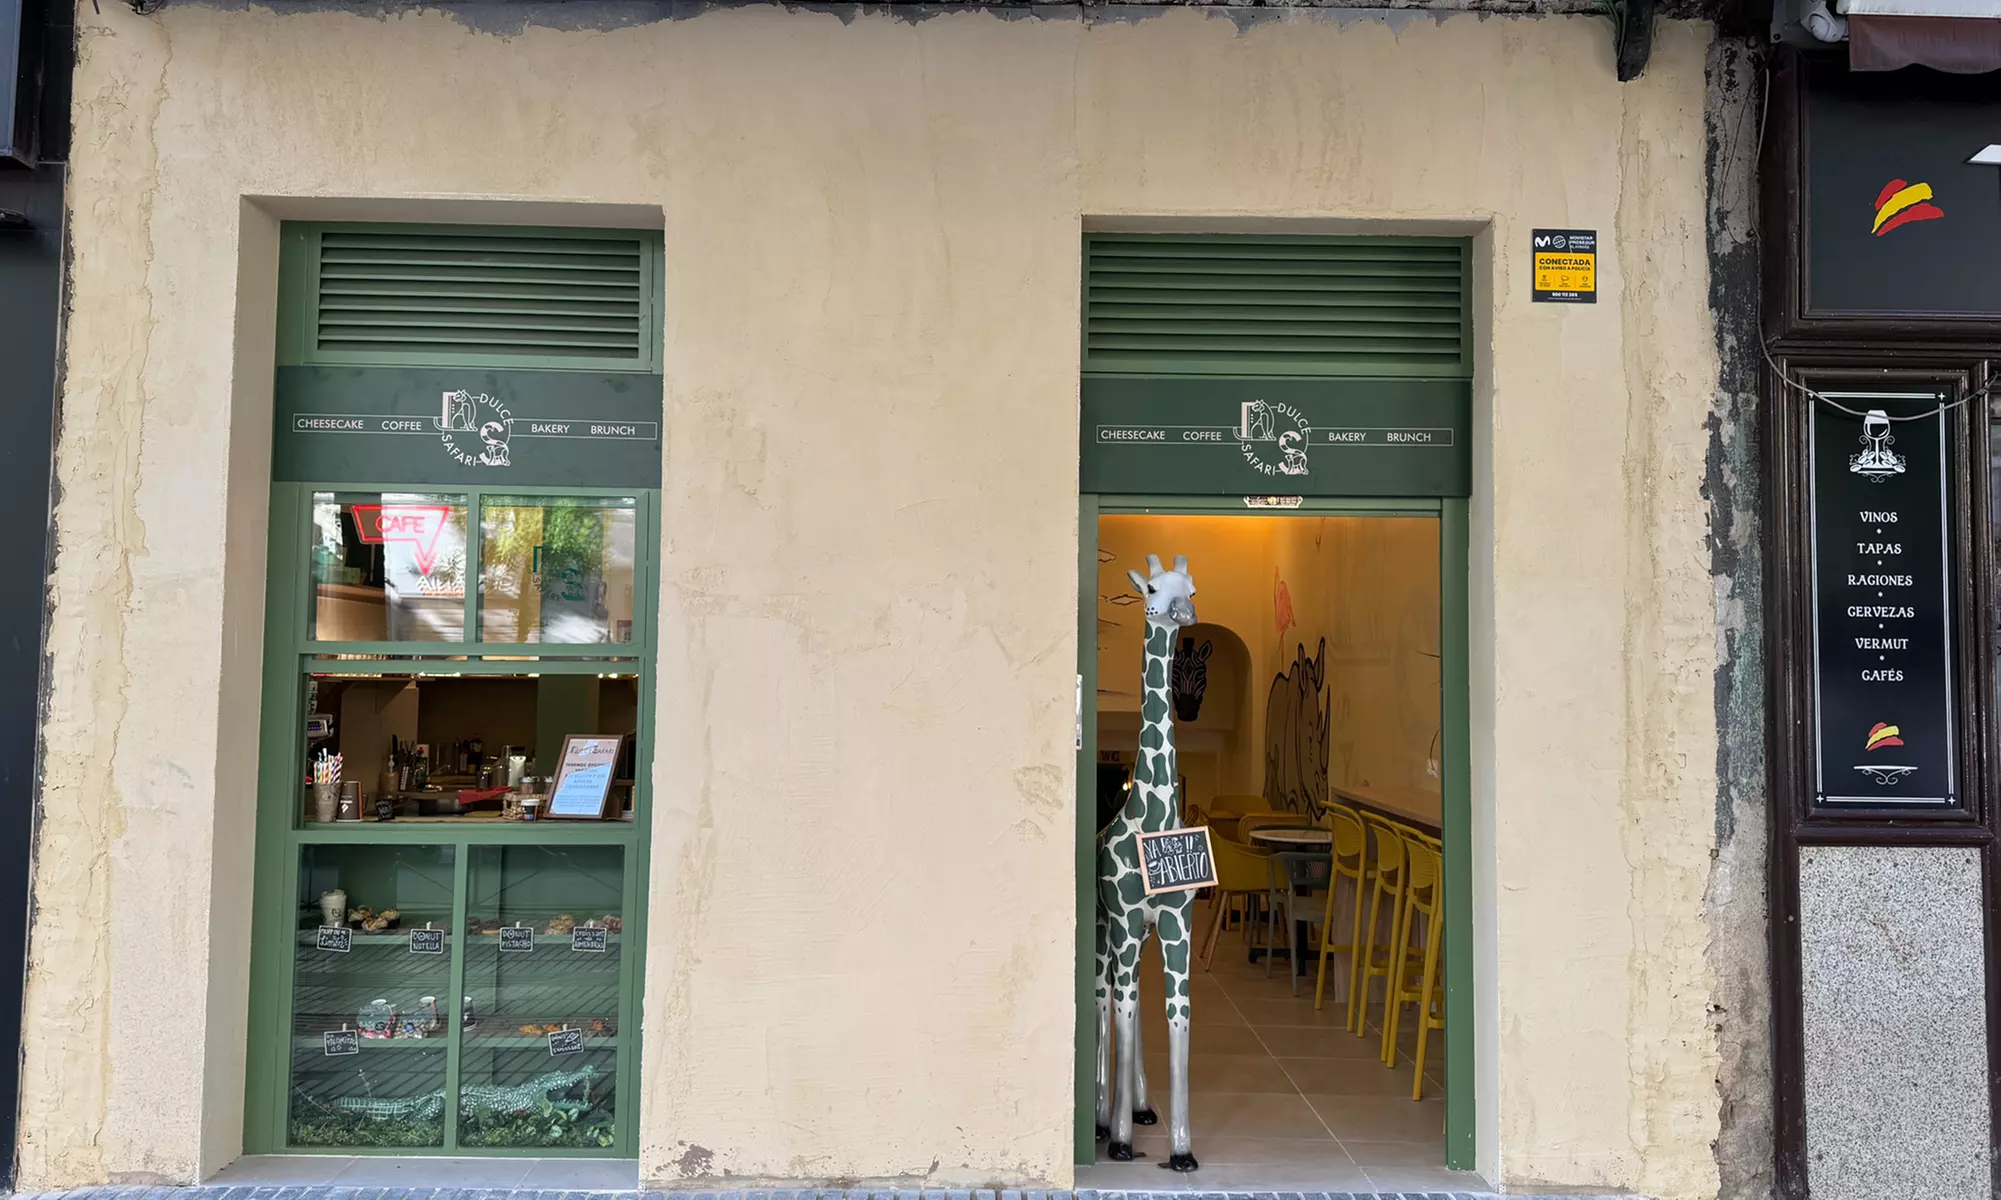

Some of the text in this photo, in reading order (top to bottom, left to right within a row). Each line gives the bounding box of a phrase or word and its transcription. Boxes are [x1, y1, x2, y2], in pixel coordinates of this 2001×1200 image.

[1539, 258, 1591, 266] CONECTADA
[479, 392, 514, 426] DULCE
[1276, 402, 1312, 434] DULCE
[297, 418, 636, 436] CHEESECAKE COFFEE BAKERY BRUNCH
[1100, 430, 1431, 443] CHEESECAKE COFFEE BAKERY BRUNCH
[441, 432, 478, 467] SAFARI
[1240, 442, 1277, 476] SAFARI
[1860, 511, 1898, 523] VINOS
[375, 516, 426, 534] CAFE
[1857, 543, 1902, 554] TAPAS
[1855, 638, 1909, 650] VERMUT
[1100, 751, 1119, 761] WC
[1144, 839, 1161, 859] YA
[1160, 852, 1209, 885] ABIERTO
[413, 932, 441, 940] DONUT
[503, 930, 530, 938] DONUT
[413, 942, 440, 950] NUTELLA
[502, 940, 531, 948] PISTACHO
